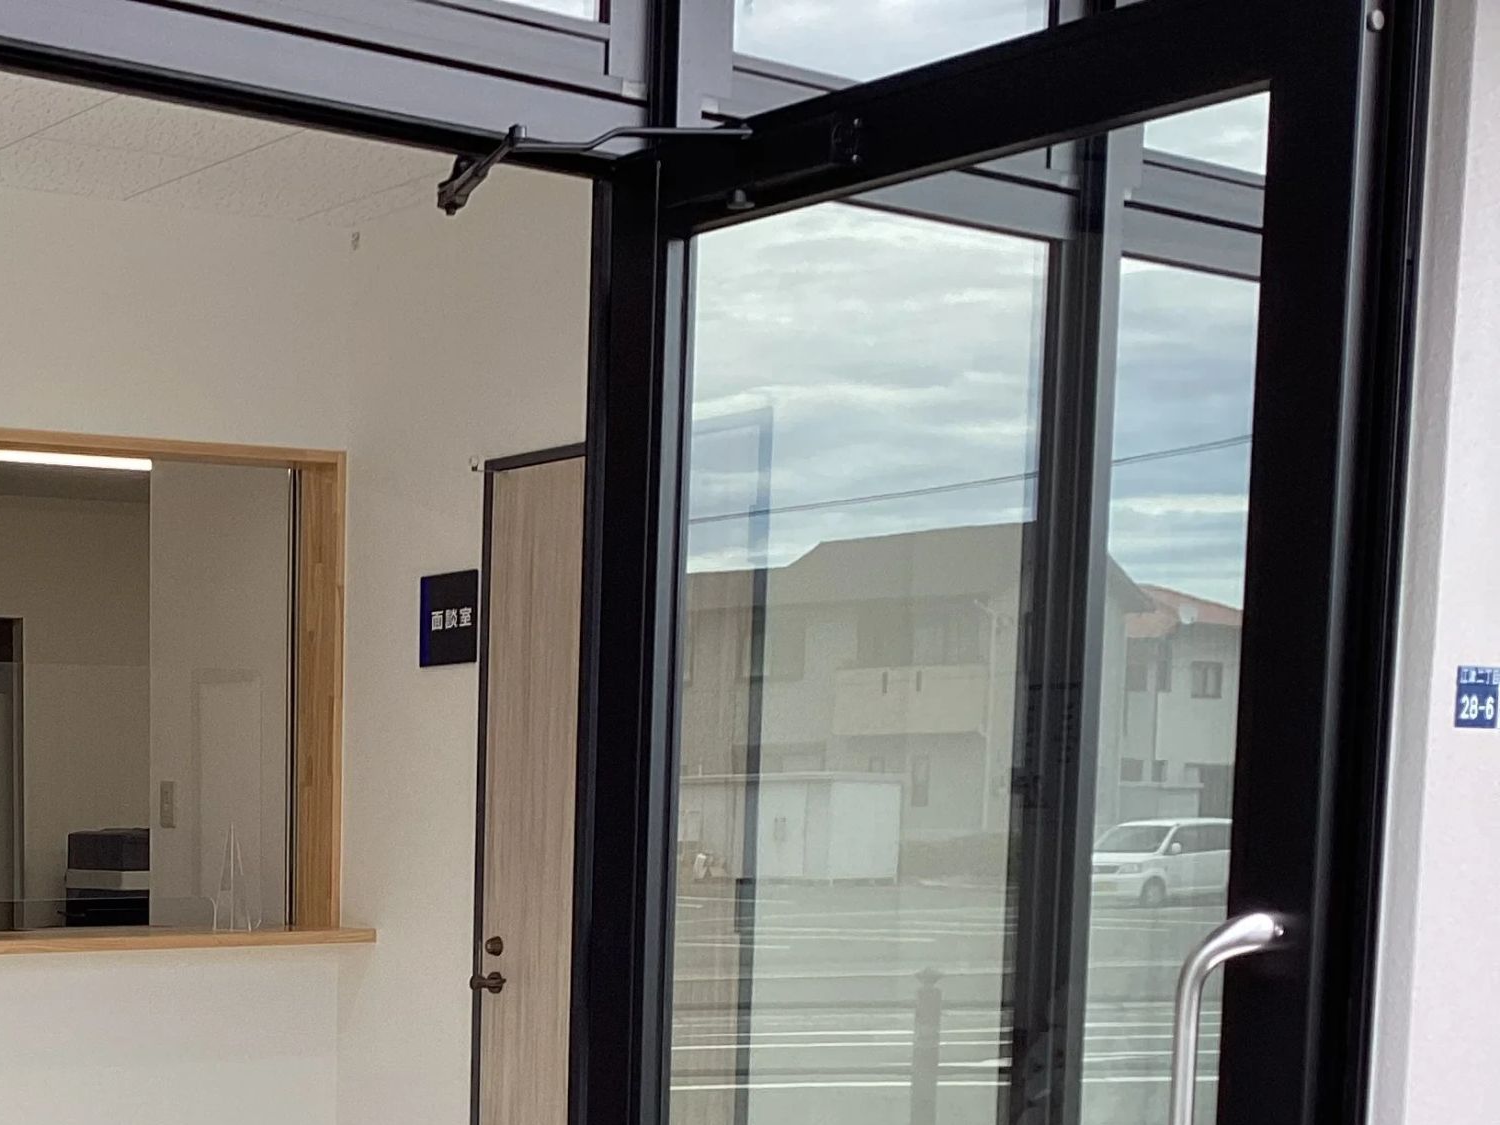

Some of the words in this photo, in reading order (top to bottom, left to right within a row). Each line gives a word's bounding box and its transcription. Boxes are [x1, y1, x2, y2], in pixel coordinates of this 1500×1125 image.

[431, 607, 472, 631] 面談室
[1460, 694, 1495, 720] 28-6
